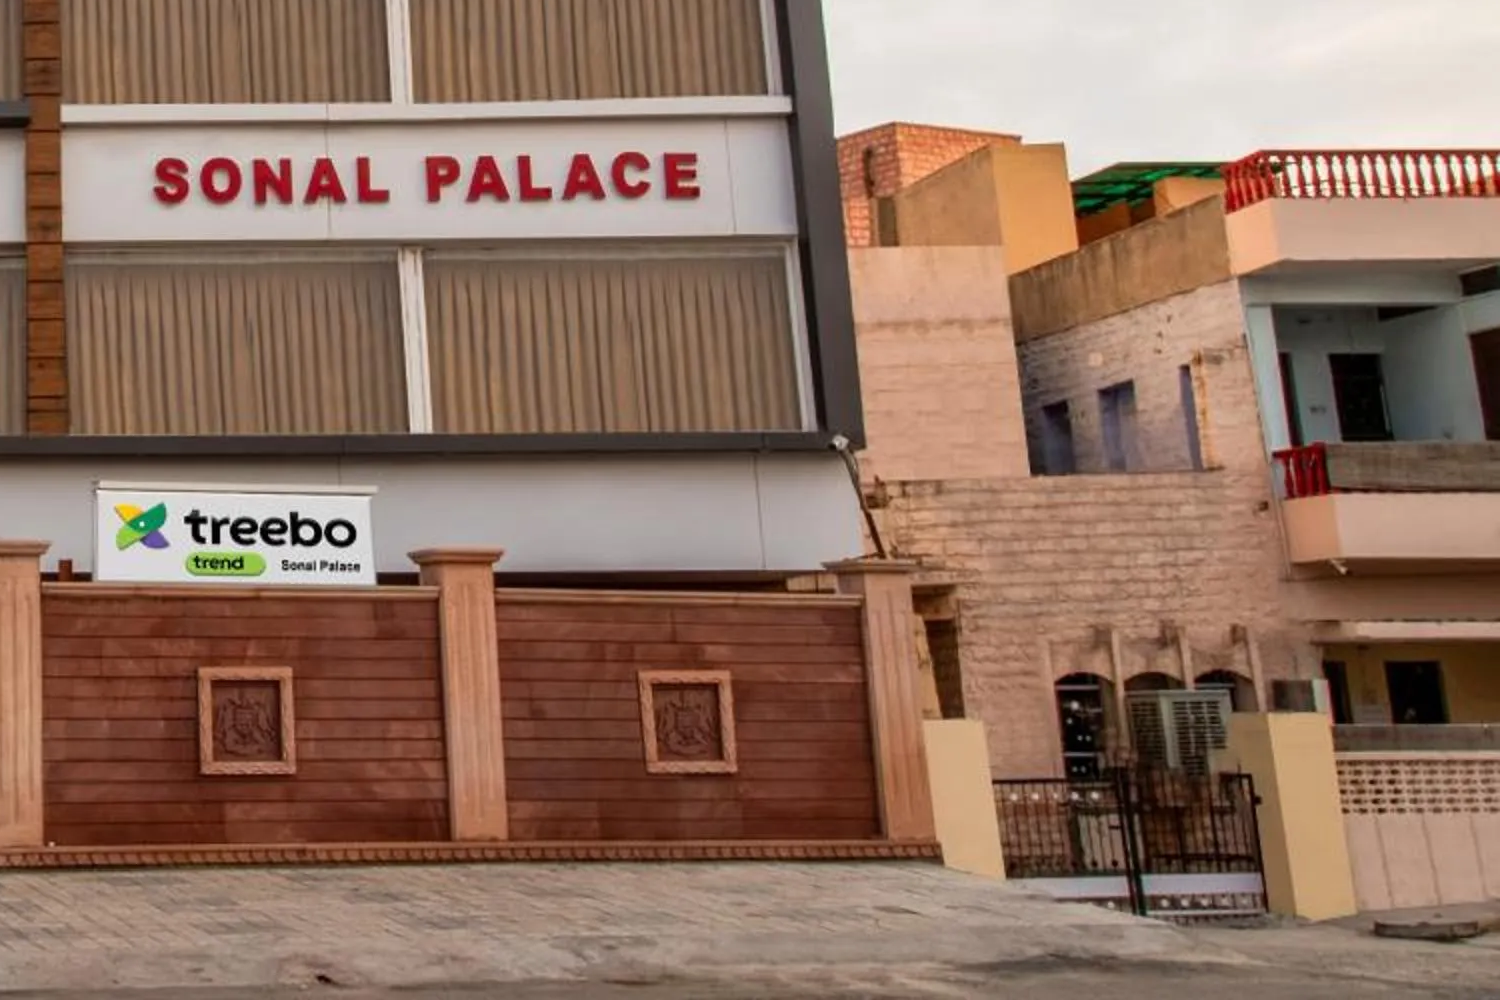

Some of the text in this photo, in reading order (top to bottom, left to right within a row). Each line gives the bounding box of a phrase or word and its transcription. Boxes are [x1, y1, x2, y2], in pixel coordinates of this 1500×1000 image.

[153, 151, 701, 206] SONAL PALACE
[183, 509, 358, 549] treebo
[193, 554, 245, 571] trend
[281, 559, 361, 574] Sonal Palace
